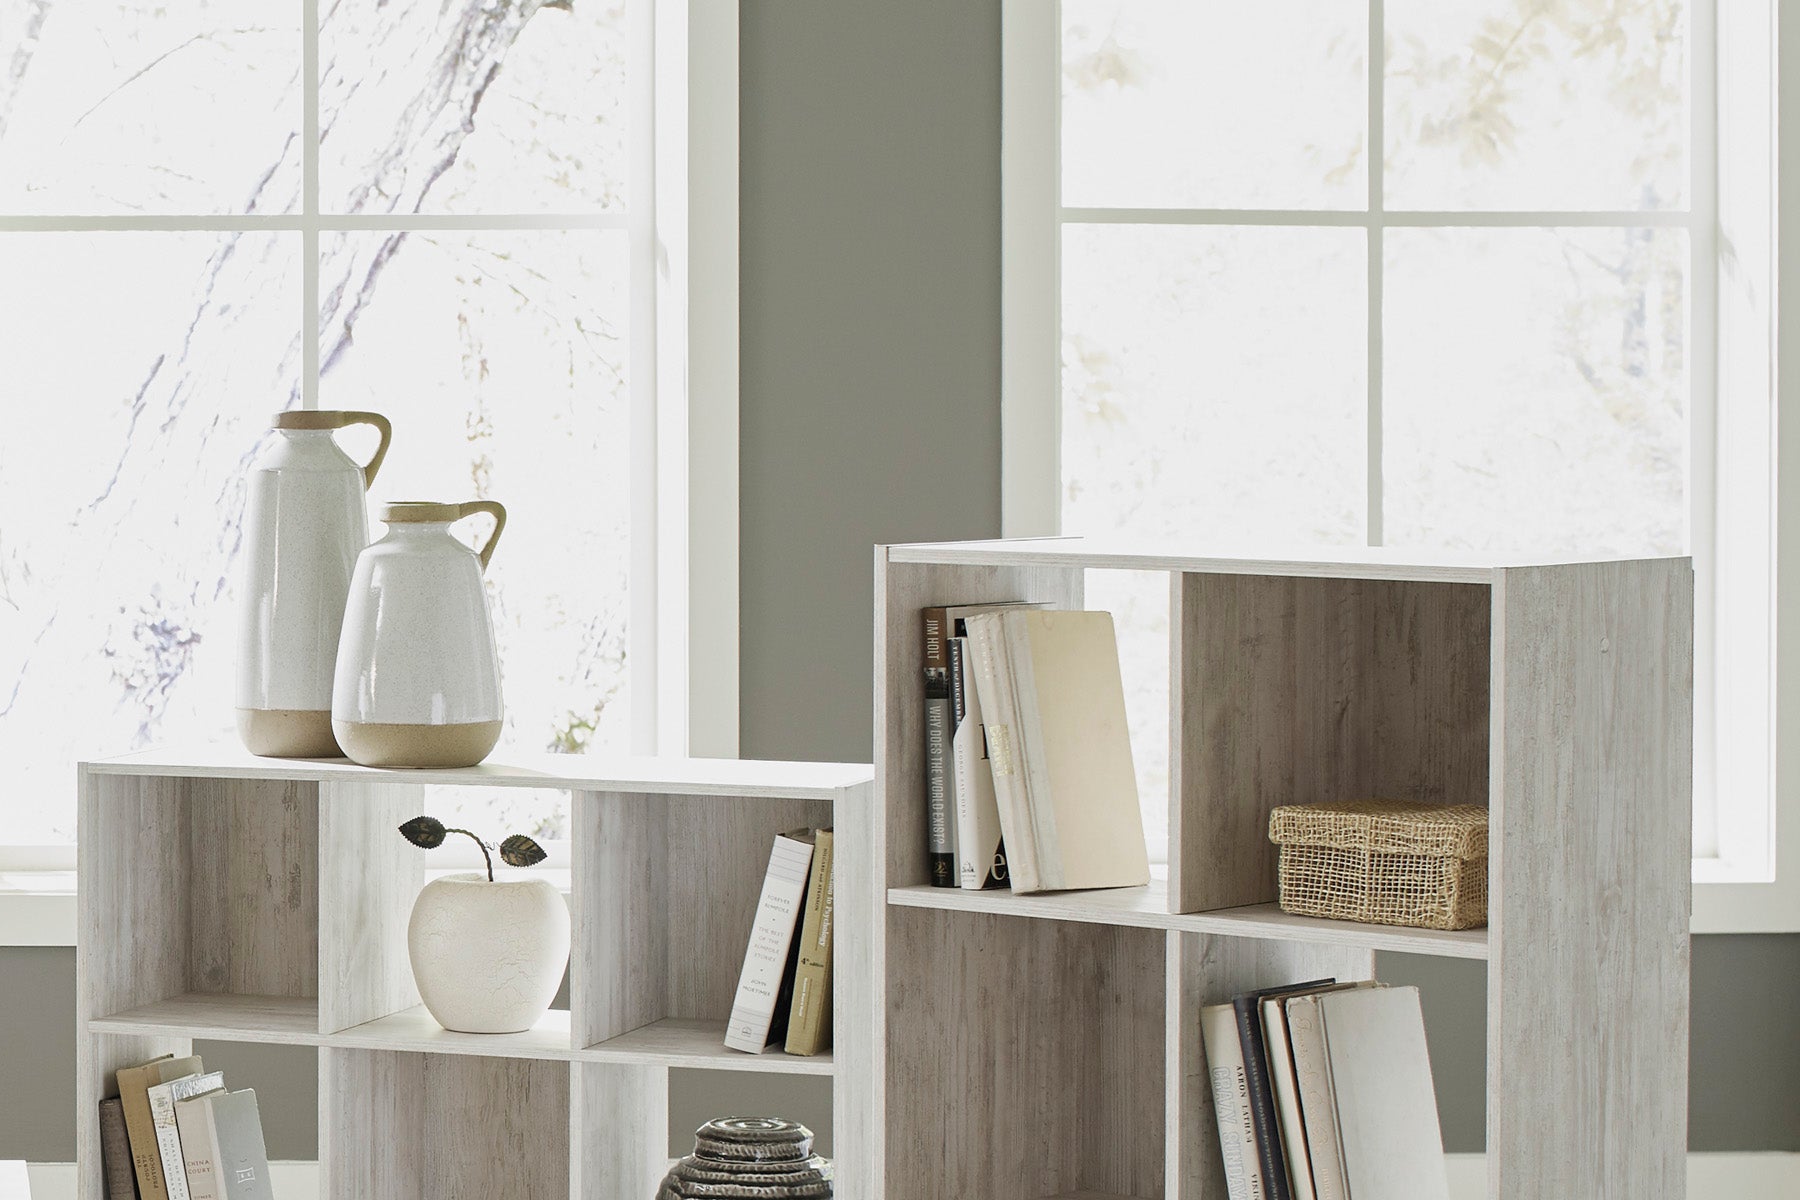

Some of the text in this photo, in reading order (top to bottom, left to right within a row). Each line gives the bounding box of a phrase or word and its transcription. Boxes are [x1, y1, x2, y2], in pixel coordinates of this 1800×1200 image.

[927, 619, 940, 660] JIM HOLT
[929, 705, 946, 845] WHY DOES THE WORLD EXIST?
[819, 906, 833, 947] Psychology
[1212, 1065, 1238, 1124] CRAZY
[1236, 1065, 1248, 1098] AARON
